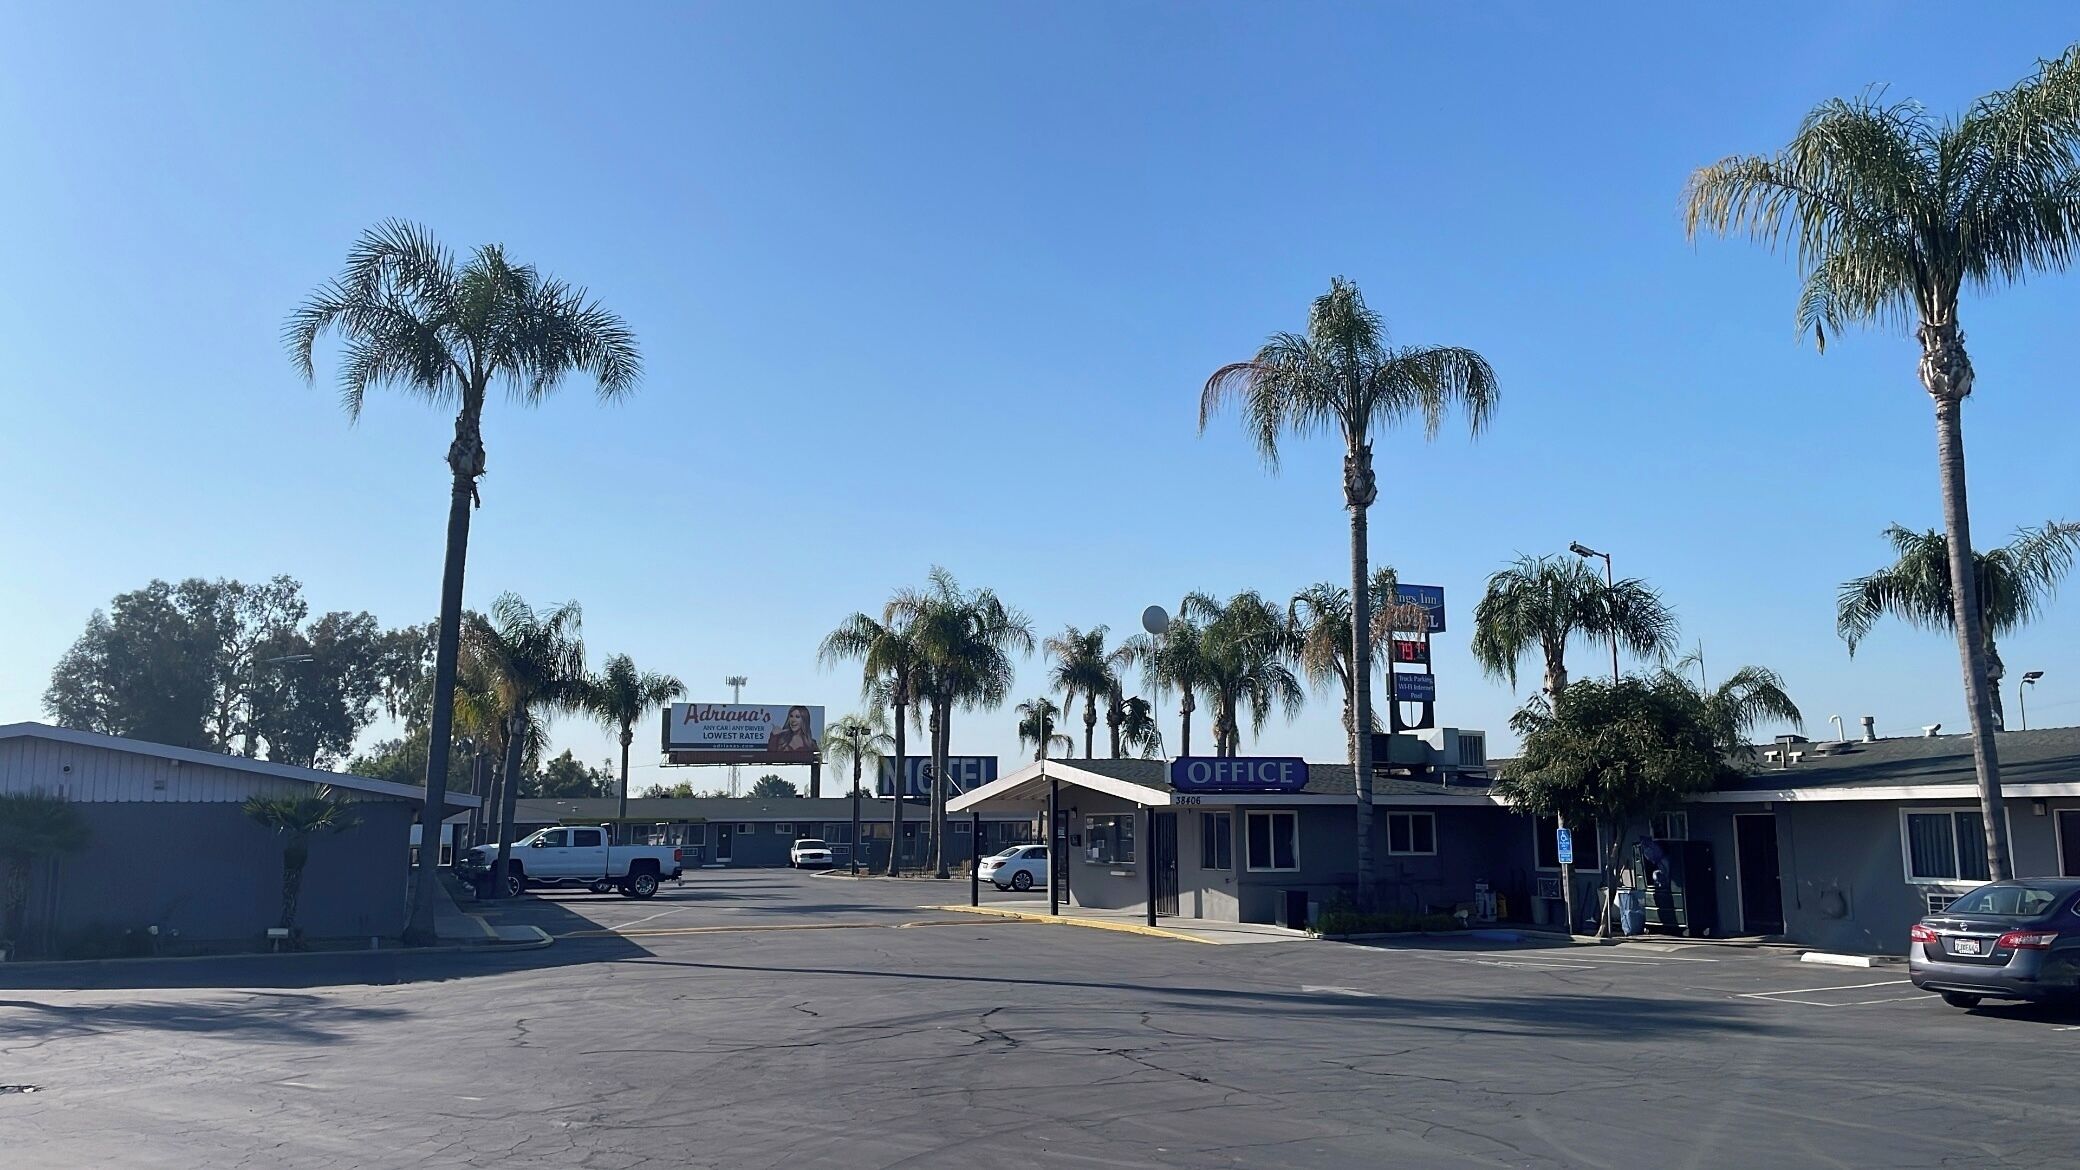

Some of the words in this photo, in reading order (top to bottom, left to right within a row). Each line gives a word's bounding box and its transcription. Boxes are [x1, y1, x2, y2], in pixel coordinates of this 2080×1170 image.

[1420, 593, 1436, 604] Inn
[684, 703, 771, 725] Adriana's
[703, 732, 737, 740] LOWEST
[739, 732, 764, 740] RATES
[1187, 761, 1293, 784] OFFICE
[1176, 796, 1201, 805] 38406
